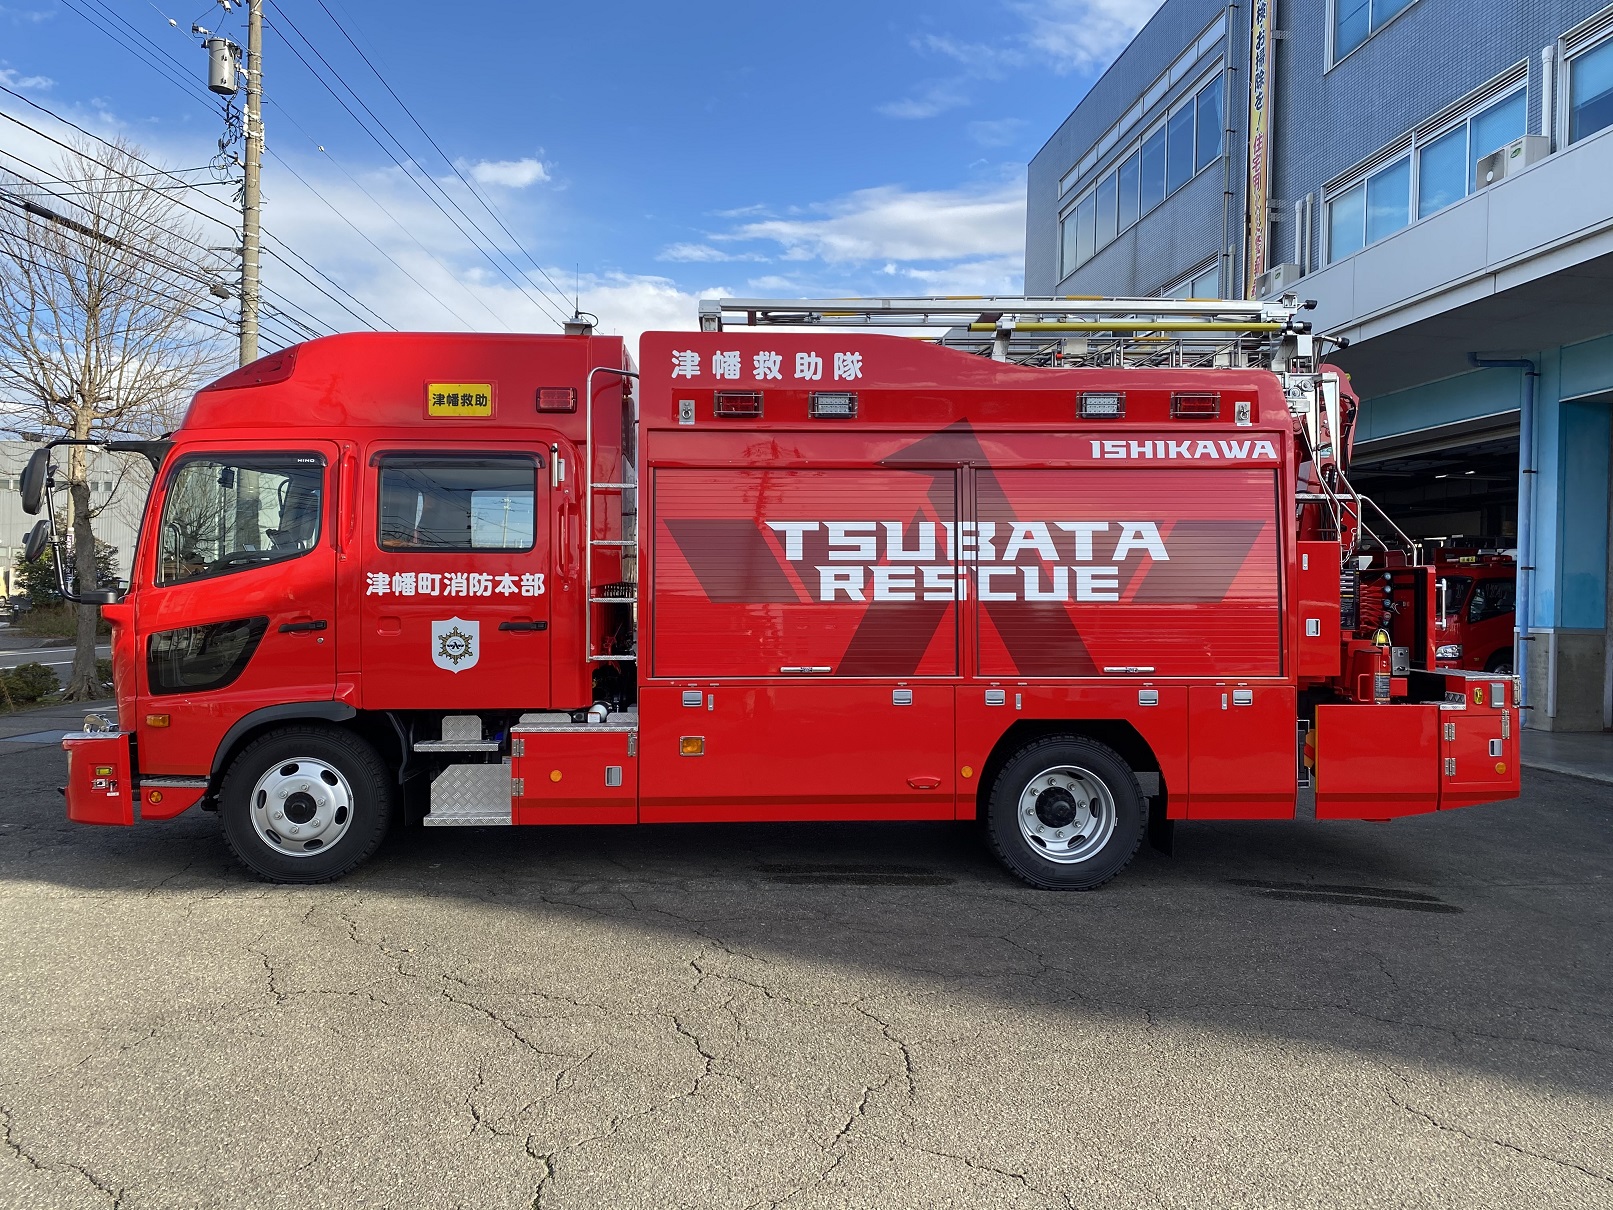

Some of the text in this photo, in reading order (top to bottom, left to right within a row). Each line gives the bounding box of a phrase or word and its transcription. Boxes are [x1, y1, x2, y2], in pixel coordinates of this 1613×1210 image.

[671, 350, 862, 380] 津幡救助隊
[432, 393, 488, 407] 津幡救助
[1089, 440, 1277, 459] ISHIKAWA
[764, 521, 1170, 561] TSUBATA
[366, 572, 545, 597] 津幡町消防本部
[814, 565, 1119, 602] RESCUE
